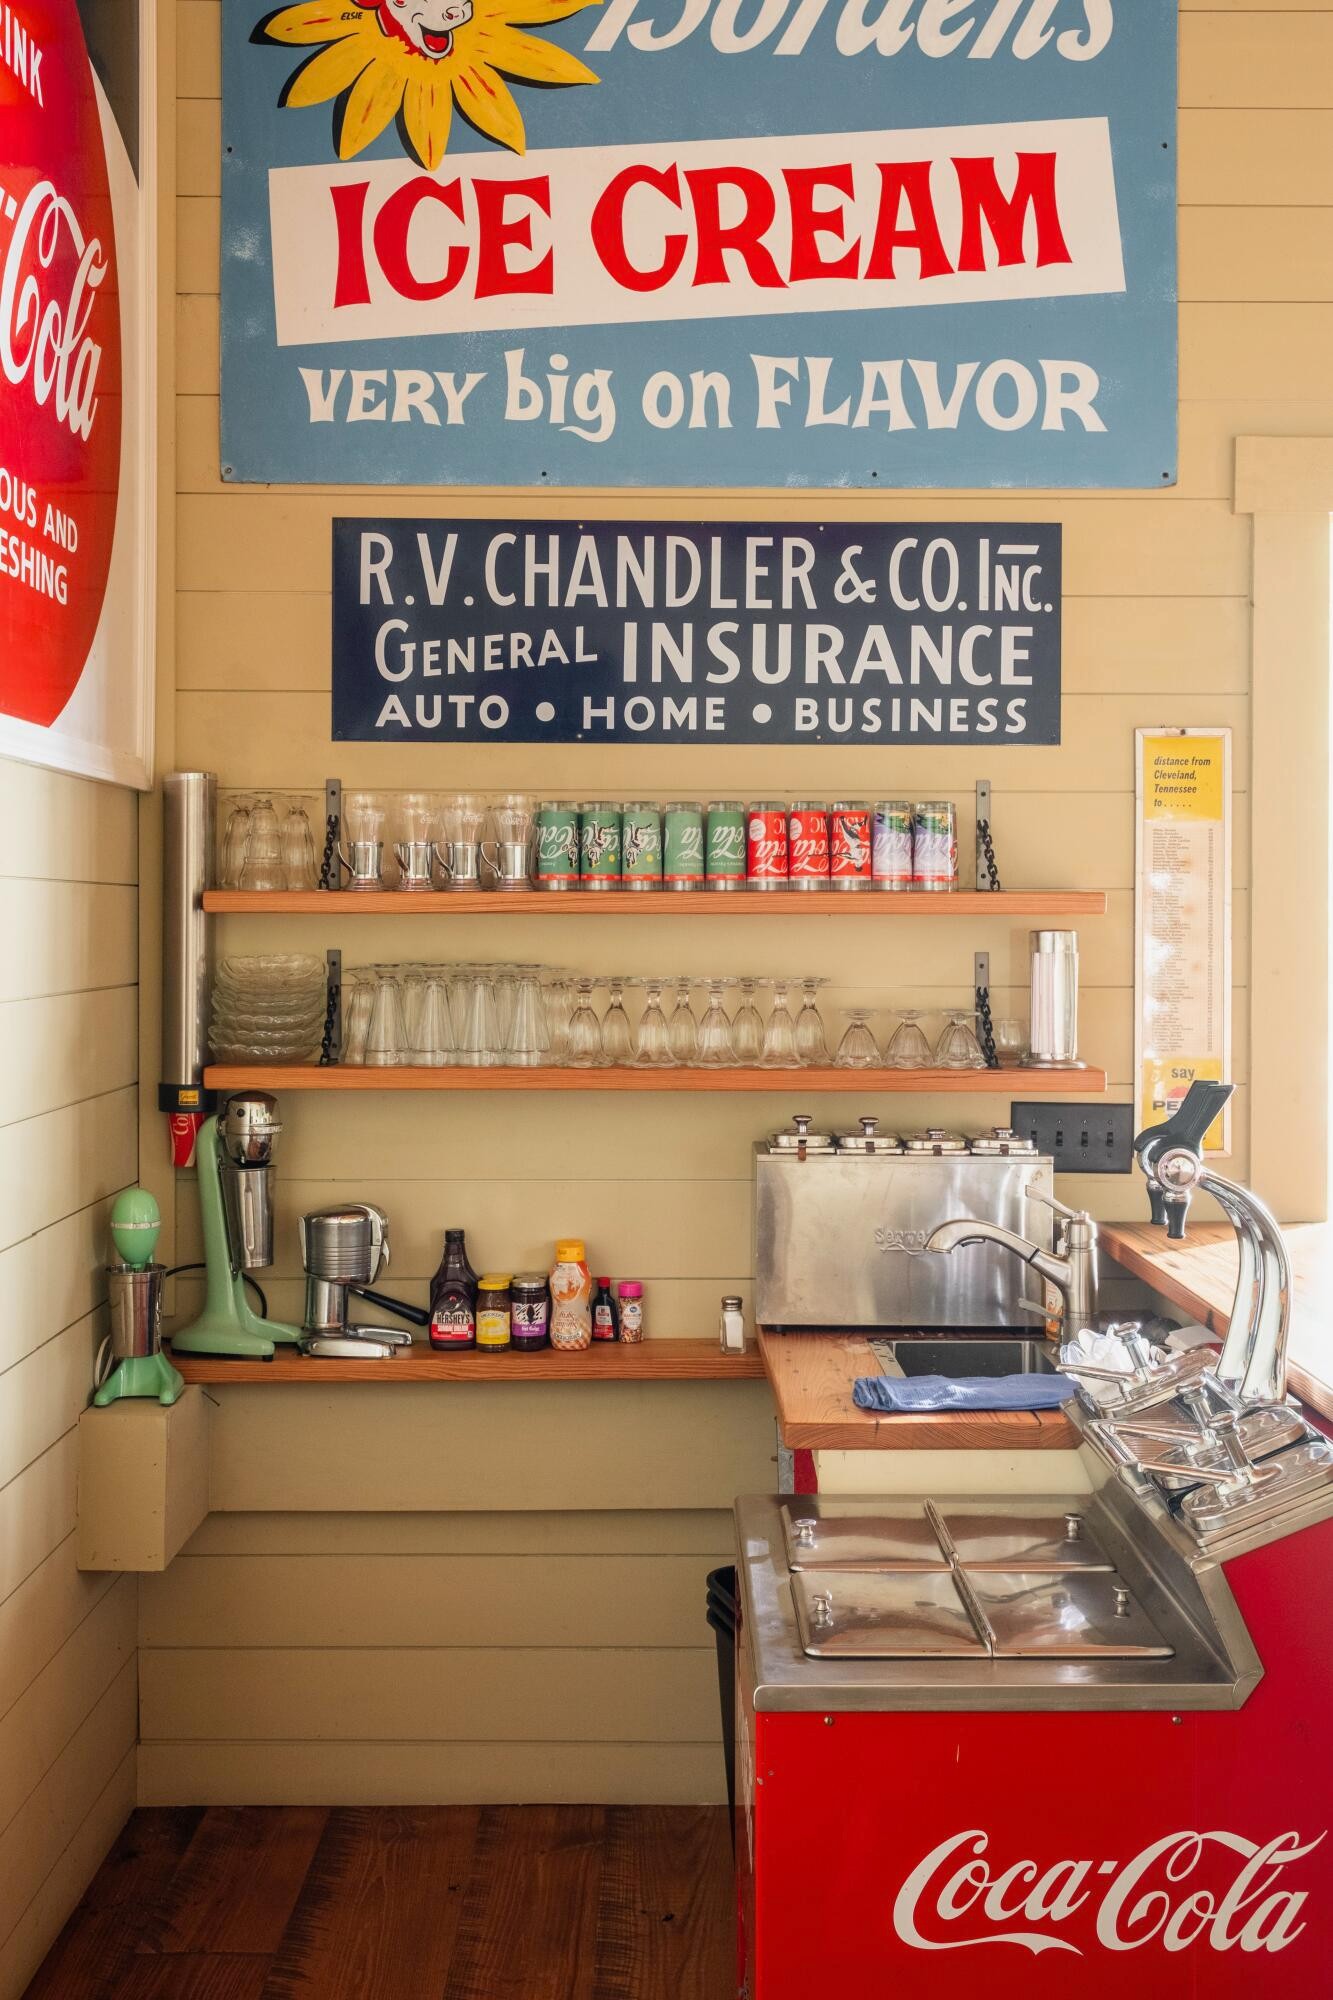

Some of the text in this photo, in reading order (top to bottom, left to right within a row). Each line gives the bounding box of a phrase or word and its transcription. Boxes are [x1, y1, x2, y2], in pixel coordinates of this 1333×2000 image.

[341, 11, 363, 21] ELSIE
[0, 3, 44, 108] INK
[330, 152, 1073, 309] ICE CREAM
[298, 348, 1108, 442] VERY big on FLAVOR
[43, 503, 78, 553] AND
[485, 533, 818, 609] CHANDLER
[834, 545, 877, 604] &
[889, 537, 968, 613] CO.
[374, 619, 1034, 686] GENERAL INSURANCE
[375, 694, 1027, 734] AUTO HOME BUSINESS
[1154, 756, 1211, 766] distance from
[1154, 770, 1197, 781] Cleveland,
[1154, 784, 1197, 793] Tennessee
[1171, 1068, 1196, 1081] say
[874, 1229, 927, 1244] Serve
[437, 1312, 470, 1324] HERSHEY'S
[893, 1830, 1328, 1956] Coca-Cola
